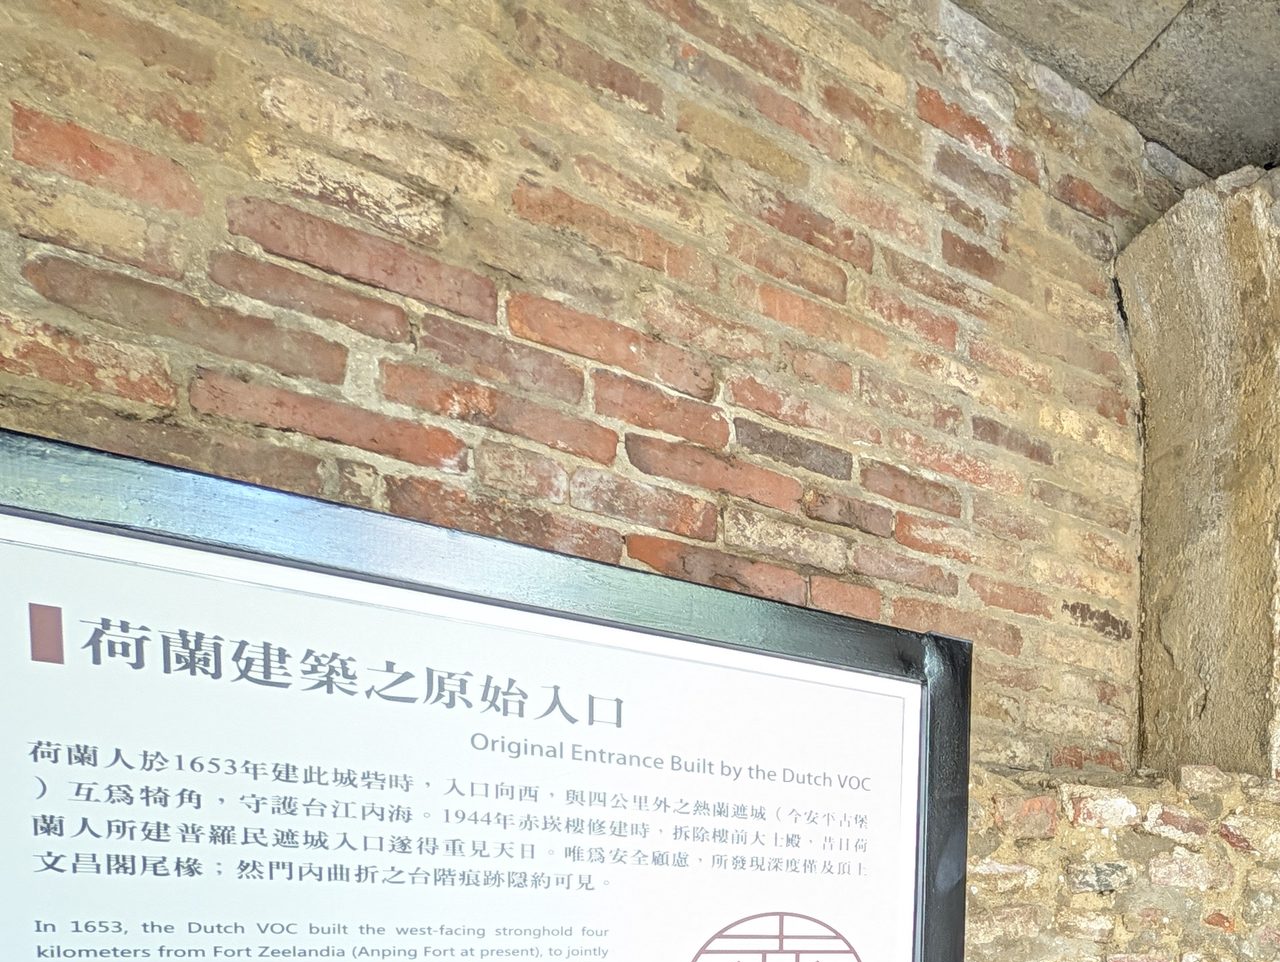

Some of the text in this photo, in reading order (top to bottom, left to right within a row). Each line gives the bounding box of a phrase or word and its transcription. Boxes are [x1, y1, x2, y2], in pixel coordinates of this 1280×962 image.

[79, 617, 624, 728] 荷蘭建築之原始入口
[471, 733, 871, 791] Original Entrance Built by the Dutch VOC
[34, 920, 608, 939] In 1653, the Dutch VOC built the west-facing stronghold four
[37, 945, 608, 960] kilometers from Fort Zeelandia (Anping Fort at present), to jointly
